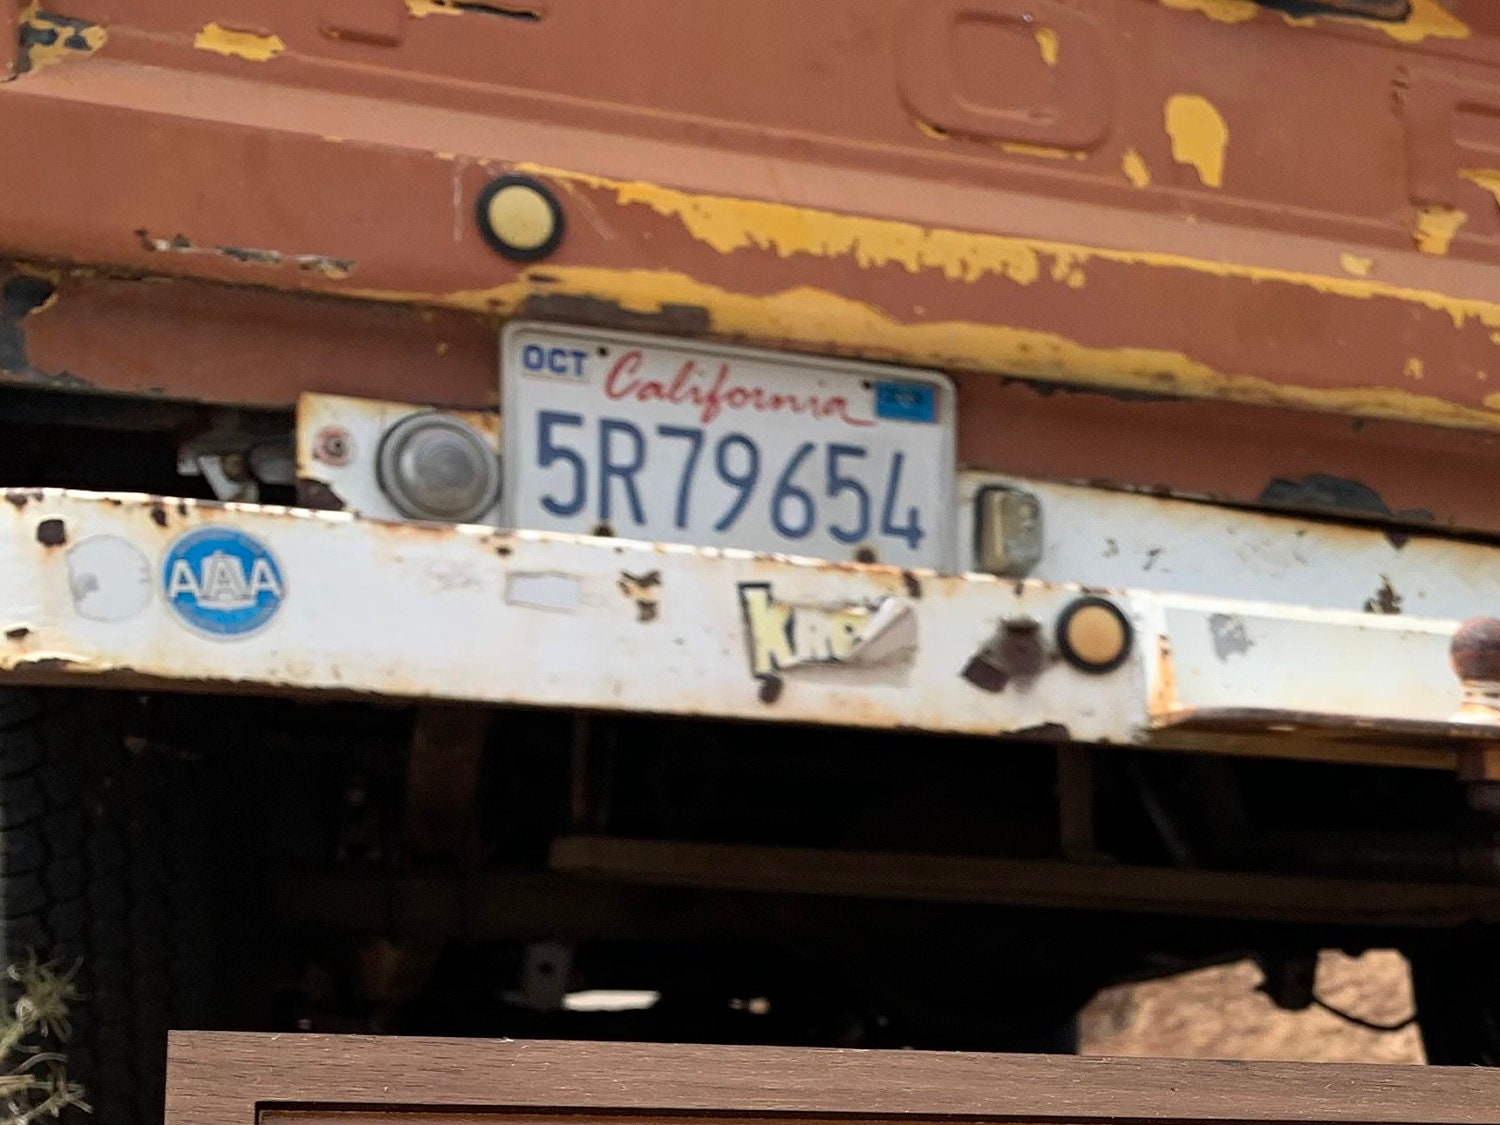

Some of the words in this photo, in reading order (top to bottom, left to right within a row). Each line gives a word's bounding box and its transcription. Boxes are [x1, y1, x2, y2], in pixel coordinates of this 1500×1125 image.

[523, 344, 588, 376] OCT
[604, 350, 877, 426] California
[537, 409, 925, 550] 5R79654
[168, 550, 282, 601] AAA
